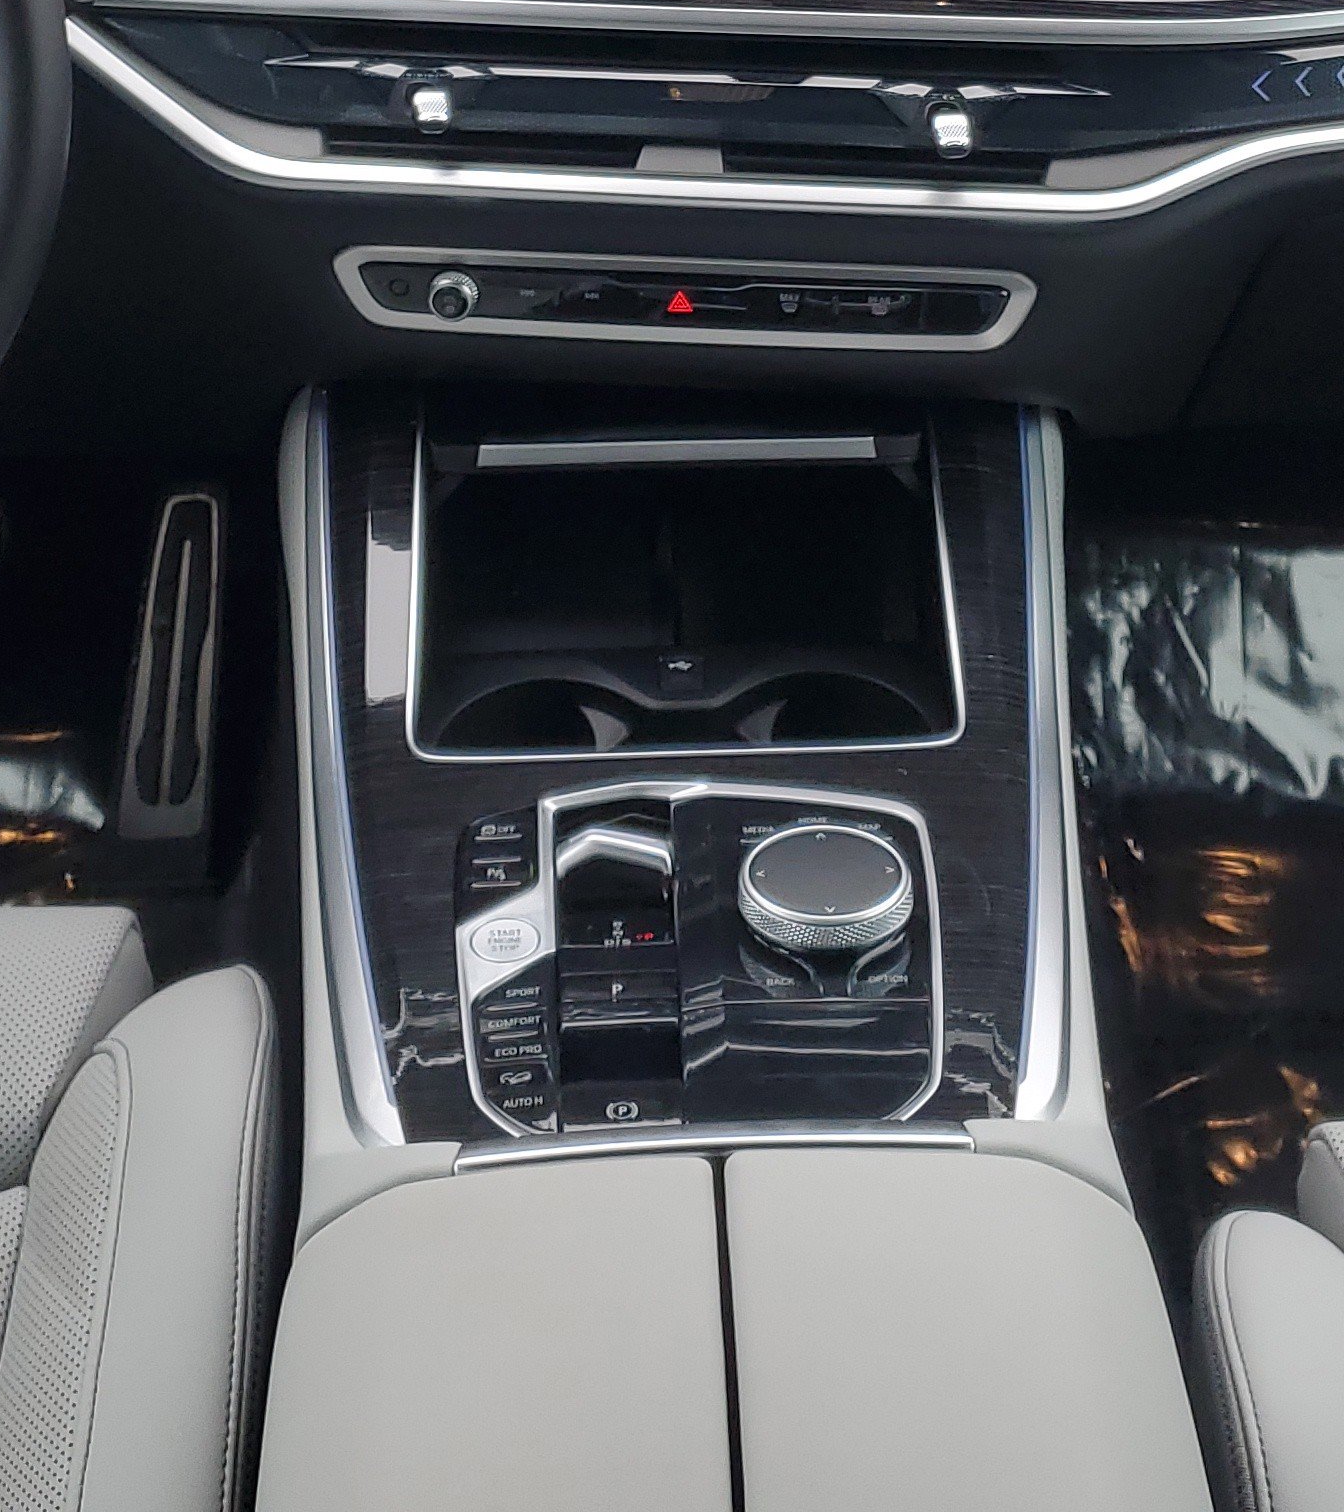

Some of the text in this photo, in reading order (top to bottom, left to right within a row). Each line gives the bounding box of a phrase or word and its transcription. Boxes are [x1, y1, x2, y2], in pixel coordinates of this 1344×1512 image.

[506, 986, 540, 998] SPORT
[494, 1044, 543, 1058] ECO PRO
[503, 1098, 532, 1109] AUTO
